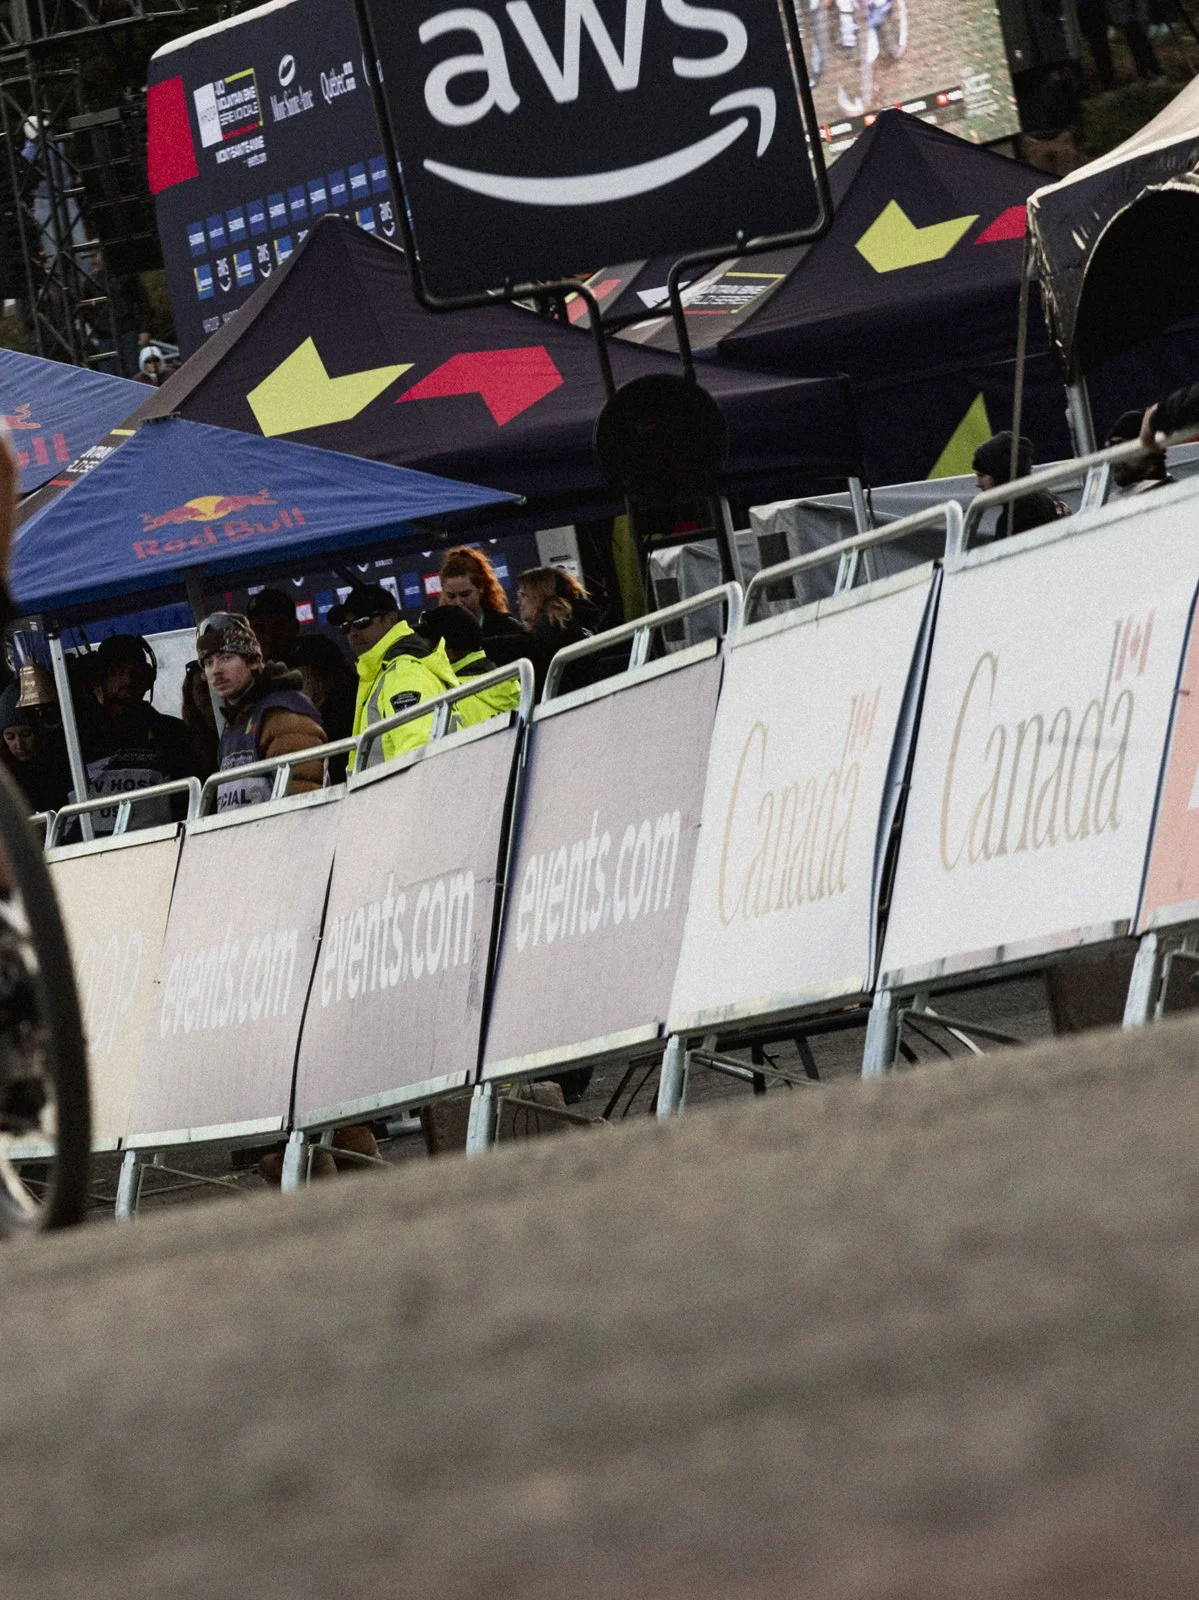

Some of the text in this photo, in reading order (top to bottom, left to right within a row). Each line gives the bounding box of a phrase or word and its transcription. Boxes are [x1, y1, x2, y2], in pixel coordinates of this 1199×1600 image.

[418, 0, 748, 126] aws
[132, 507, 305, 560] Red Bull
[718, 694, 860, 926] Canada
[939, 618, 1135, 871] Canada
[321, 870, 475, 1008] events.com
[516, 810, 681, 953] events.com
[160, 921, 298, 1039] events.com
